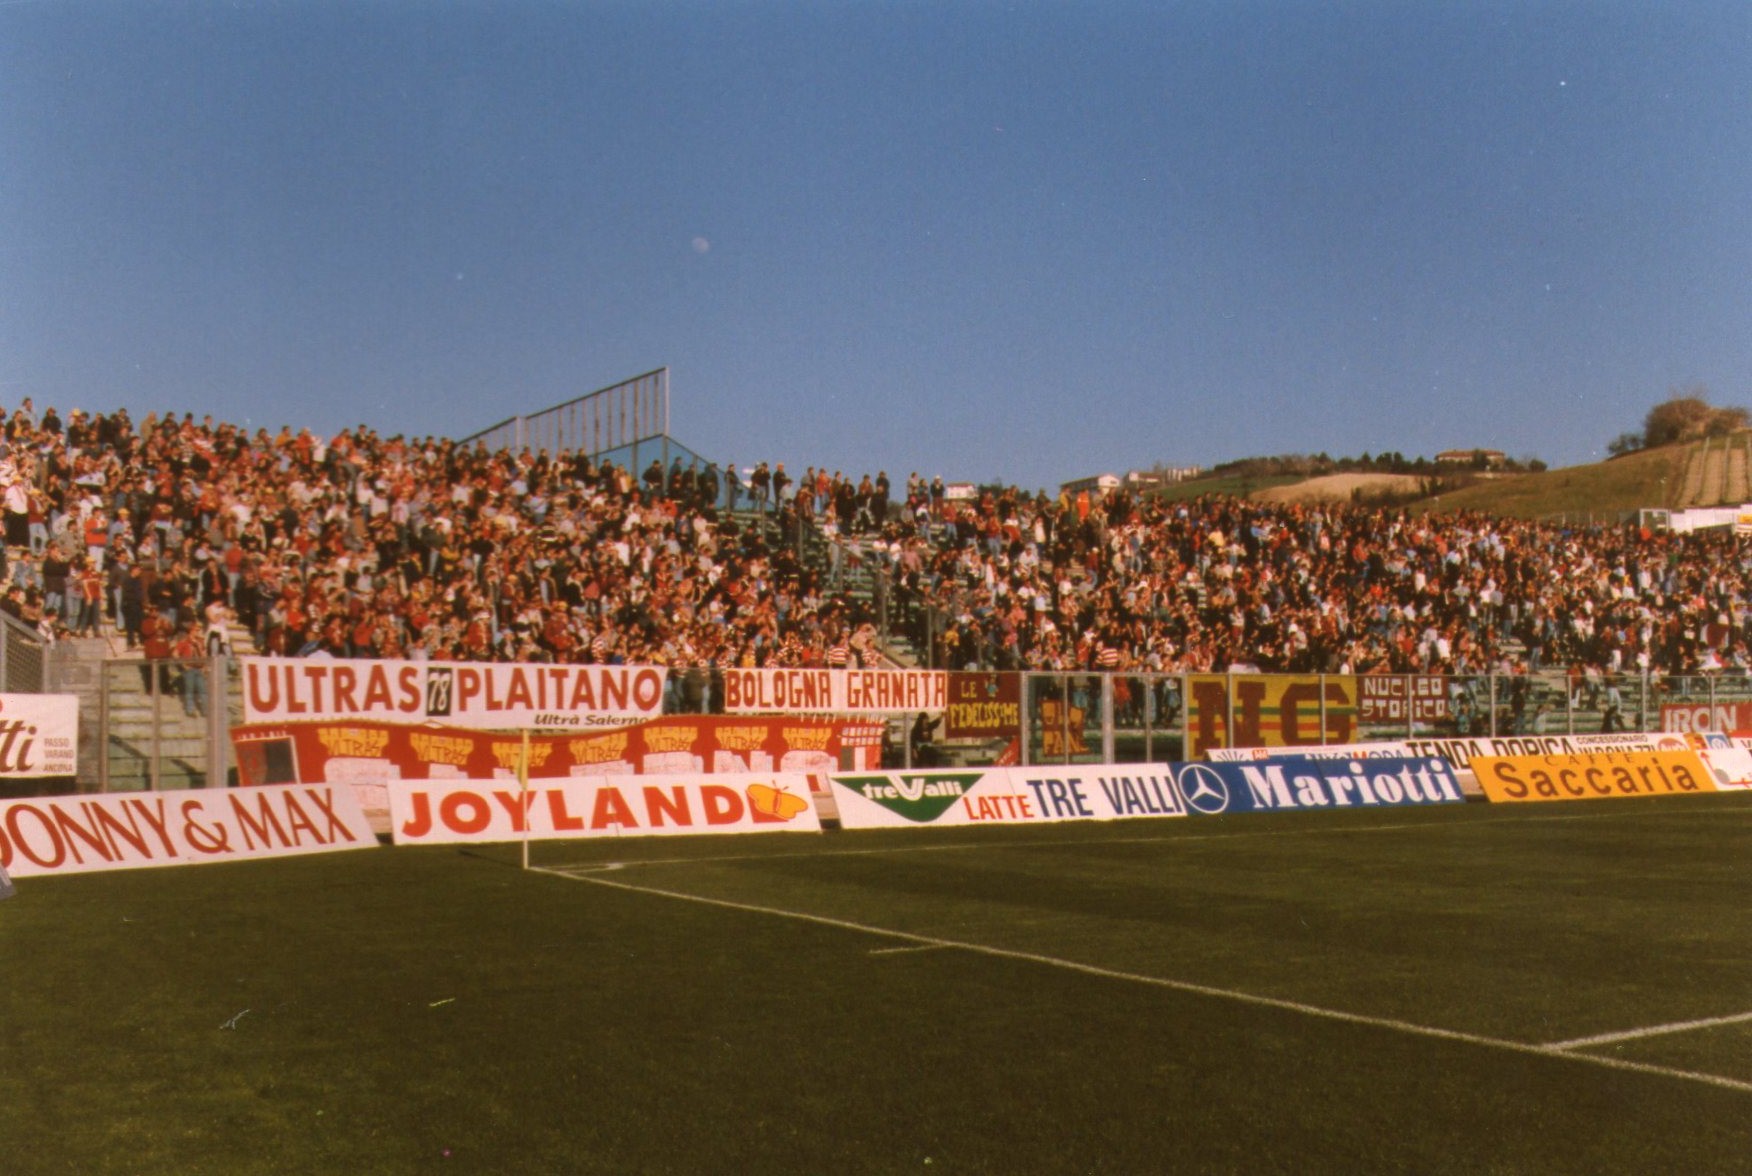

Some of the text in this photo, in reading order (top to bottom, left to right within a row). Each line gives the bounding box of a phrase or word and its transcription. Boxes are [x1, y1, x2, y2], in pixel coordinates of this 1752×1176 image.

[248, 664, 662, 713] ULTRAS 78 PLAITANO
[726, 670, 946, 708] BOLOGNA GRANATA
[960, 681, 978, 699] LE
[1364, 677, 1443, 696] NUCLEO
[534, 714, 649, 726] Ultrà Salerno
[1192, 681, 1351, 762] NG
[1664, 706, 1737, 733] IRON
[1406, 741, 1483, 770] TENDA
[1576, 735, 1648, 744] CONCESSIONARIO
[1239, 759, 1460, 808] Mariotti
[1493, 758, 1698, 798] Saccaria
[402, 785, 744, 837] JOYLAND
[963, 776, 1181, 820] LATTE TRE VALLI
[181, 799, 234, 854] &
[229, 788, 356, 851] MAX
